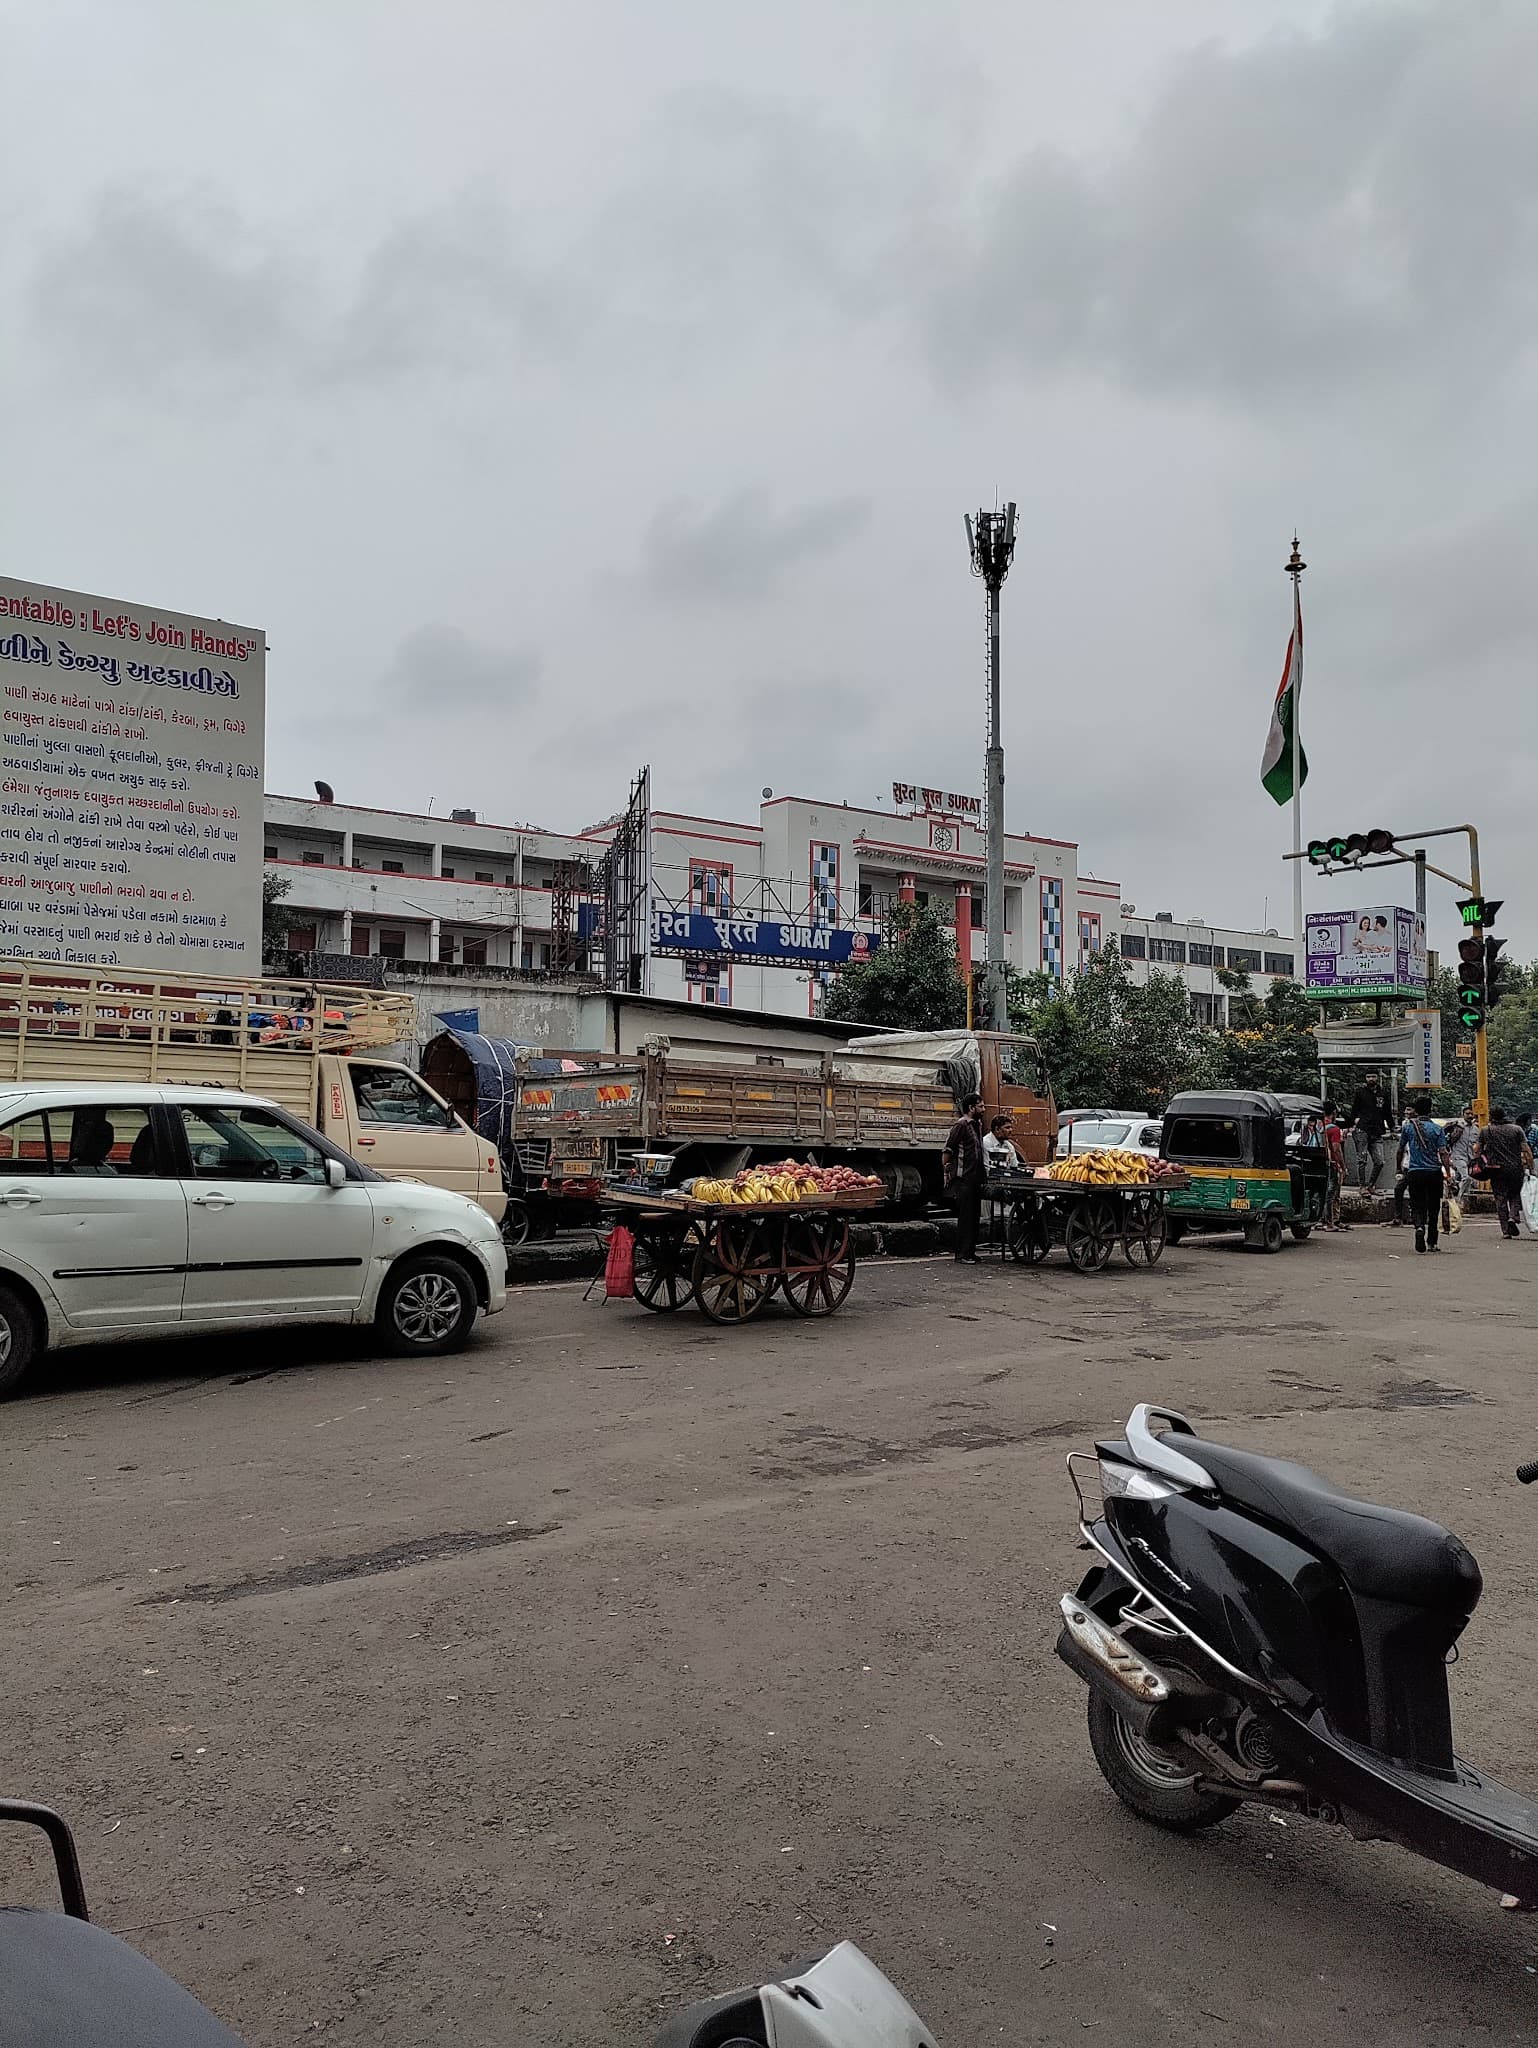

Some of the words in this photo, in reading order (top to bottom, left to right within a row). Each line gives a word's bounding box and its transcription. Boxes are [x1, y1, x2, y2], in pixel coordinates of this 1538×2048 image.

[92, 609, 140, 641] Let's
[146, 621, 185, 649] Join
[191, 628, 256, 661] Hands"
[126, 661, 239, 699] અટકાવીએ
[4, 686, 27, 699] પાણી
[68, 763, 87, 777] એક
[91, 769, 115, 781] વખત
[171, 778, 190, 790] કરો.
[948, 794, 981, 813] SURAT
[222, 806, 240, 819] કરો.
[1, 828, 20, 838] તાવ
[48, 829, 59, 843] તો
[126, 815, 144, 829] તેવા
[223, 830, 238, 841] પણ
[170, 892, 179, 901] ન
[28, 902, 40, 912] પર
[780, 927, 832, 950] SURAT
[100, 951, 120, 964] કરો.
